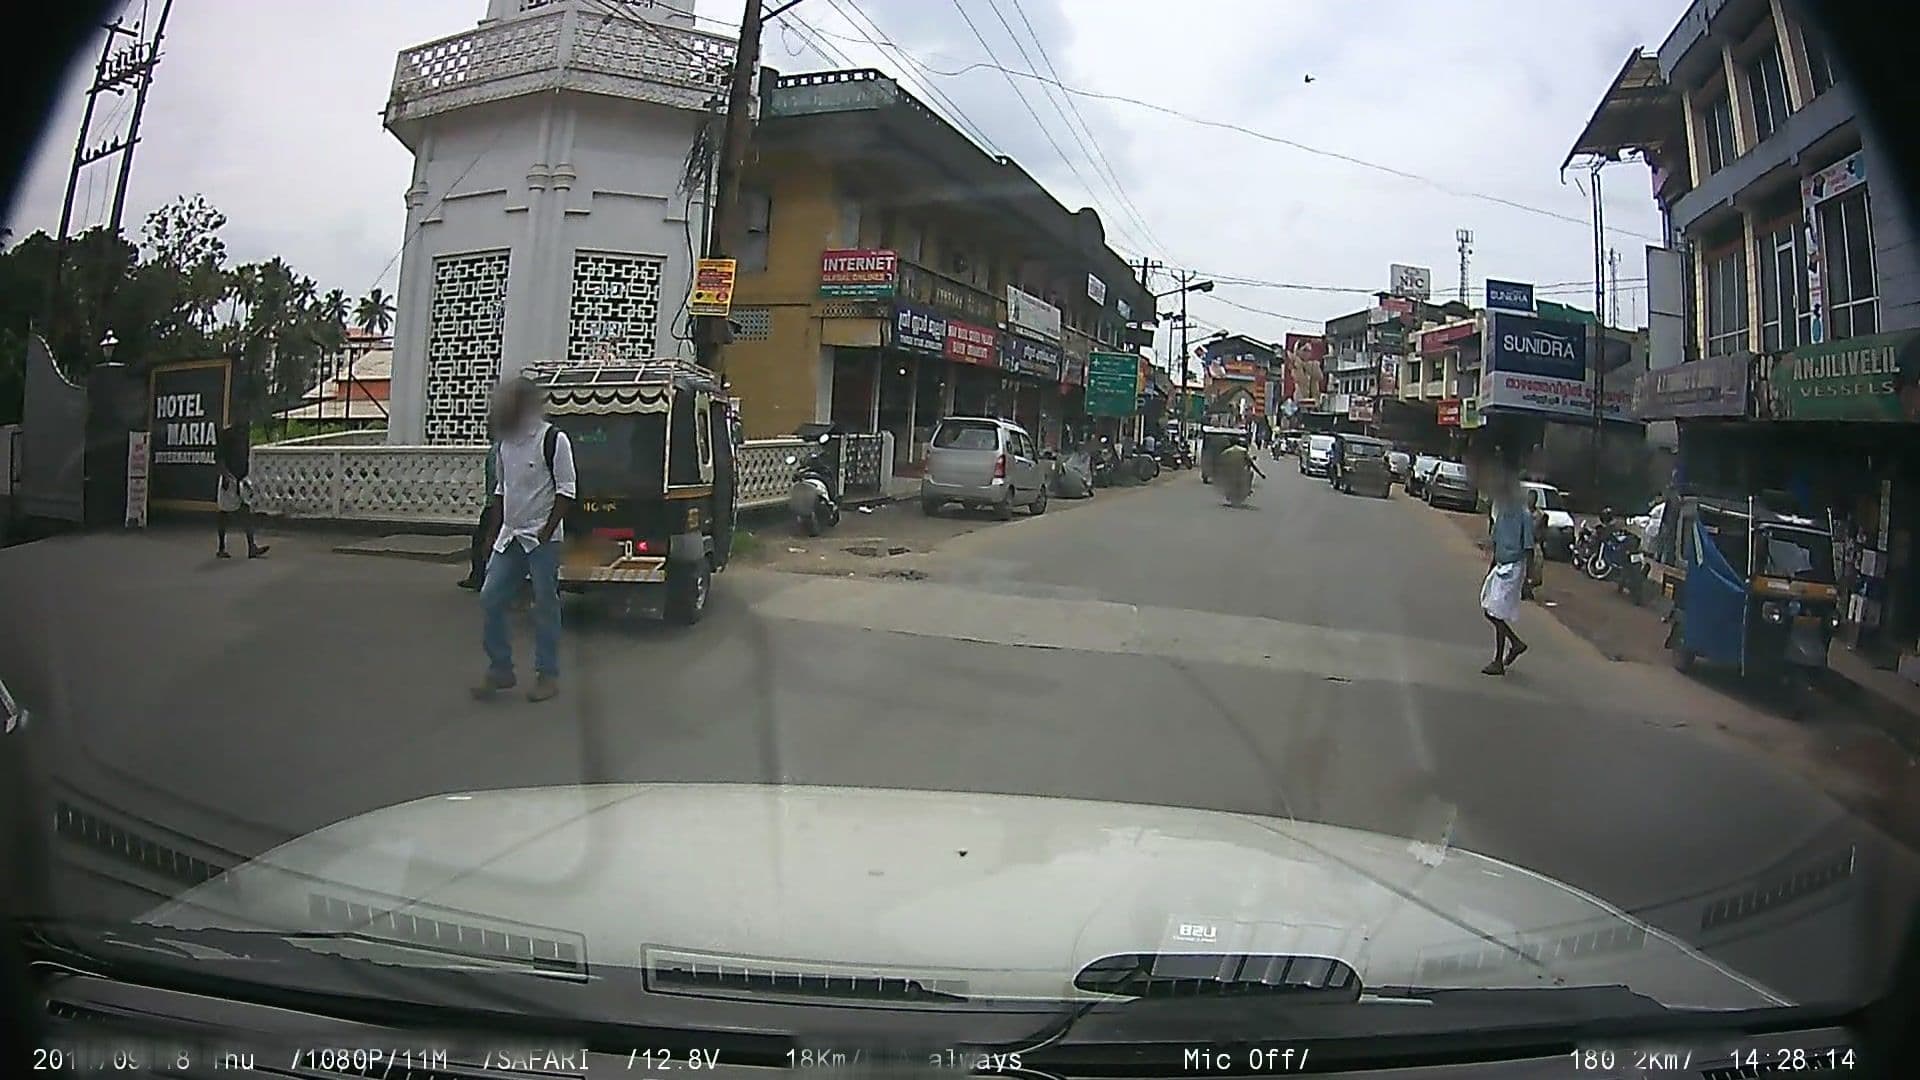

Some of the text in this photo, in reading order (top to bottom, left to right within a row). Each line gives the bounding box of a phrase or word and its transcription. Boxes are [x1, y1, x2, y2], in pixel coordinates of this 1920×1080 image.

[823, 256, 895, 272] INTERNET
[1503, 334, 1575, 360] SUNIDRA
[1800, 380, 1896, 397] VESSELS
[156, 393, 205, 418] HOTEL
[167, 421, 217, 446] MARIA
[155, 450, 216, 464] INTERNATIONAL
